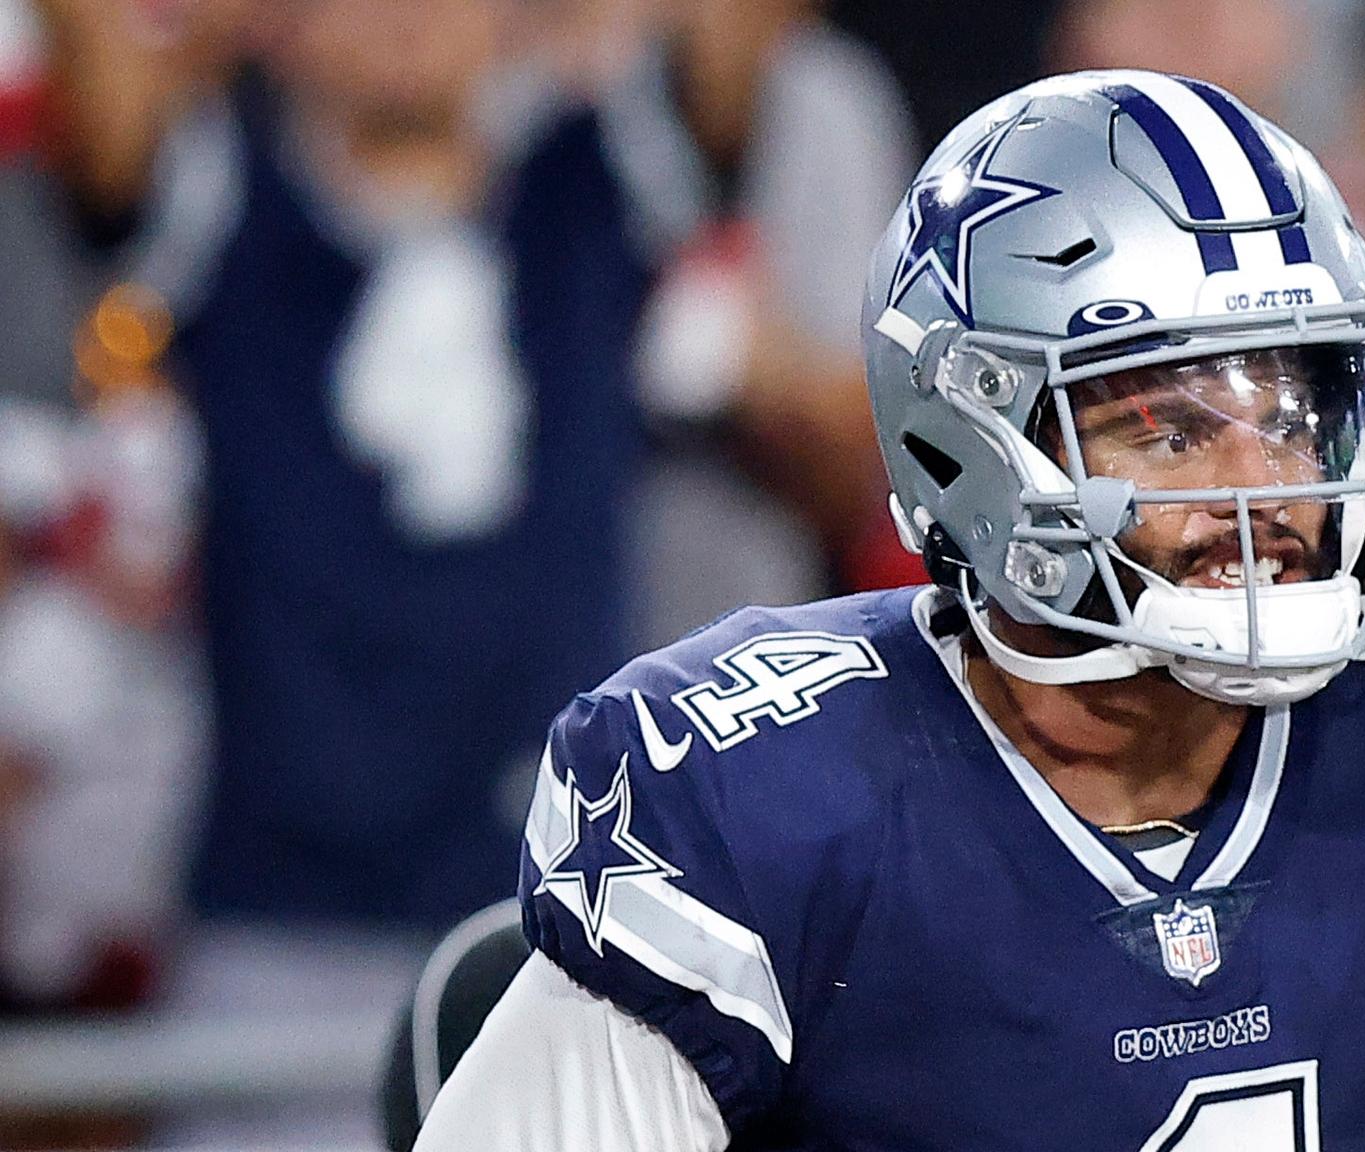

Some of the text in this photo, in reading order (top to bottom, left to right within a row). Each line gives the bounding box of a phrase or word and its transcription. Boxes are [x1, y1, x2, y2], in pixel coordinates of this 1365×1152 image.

[671, 631, 889, 753] 4
[1171, 937, 1212, 967] NFL
[1114, 1005, 1270, 1063] COWBOYS
